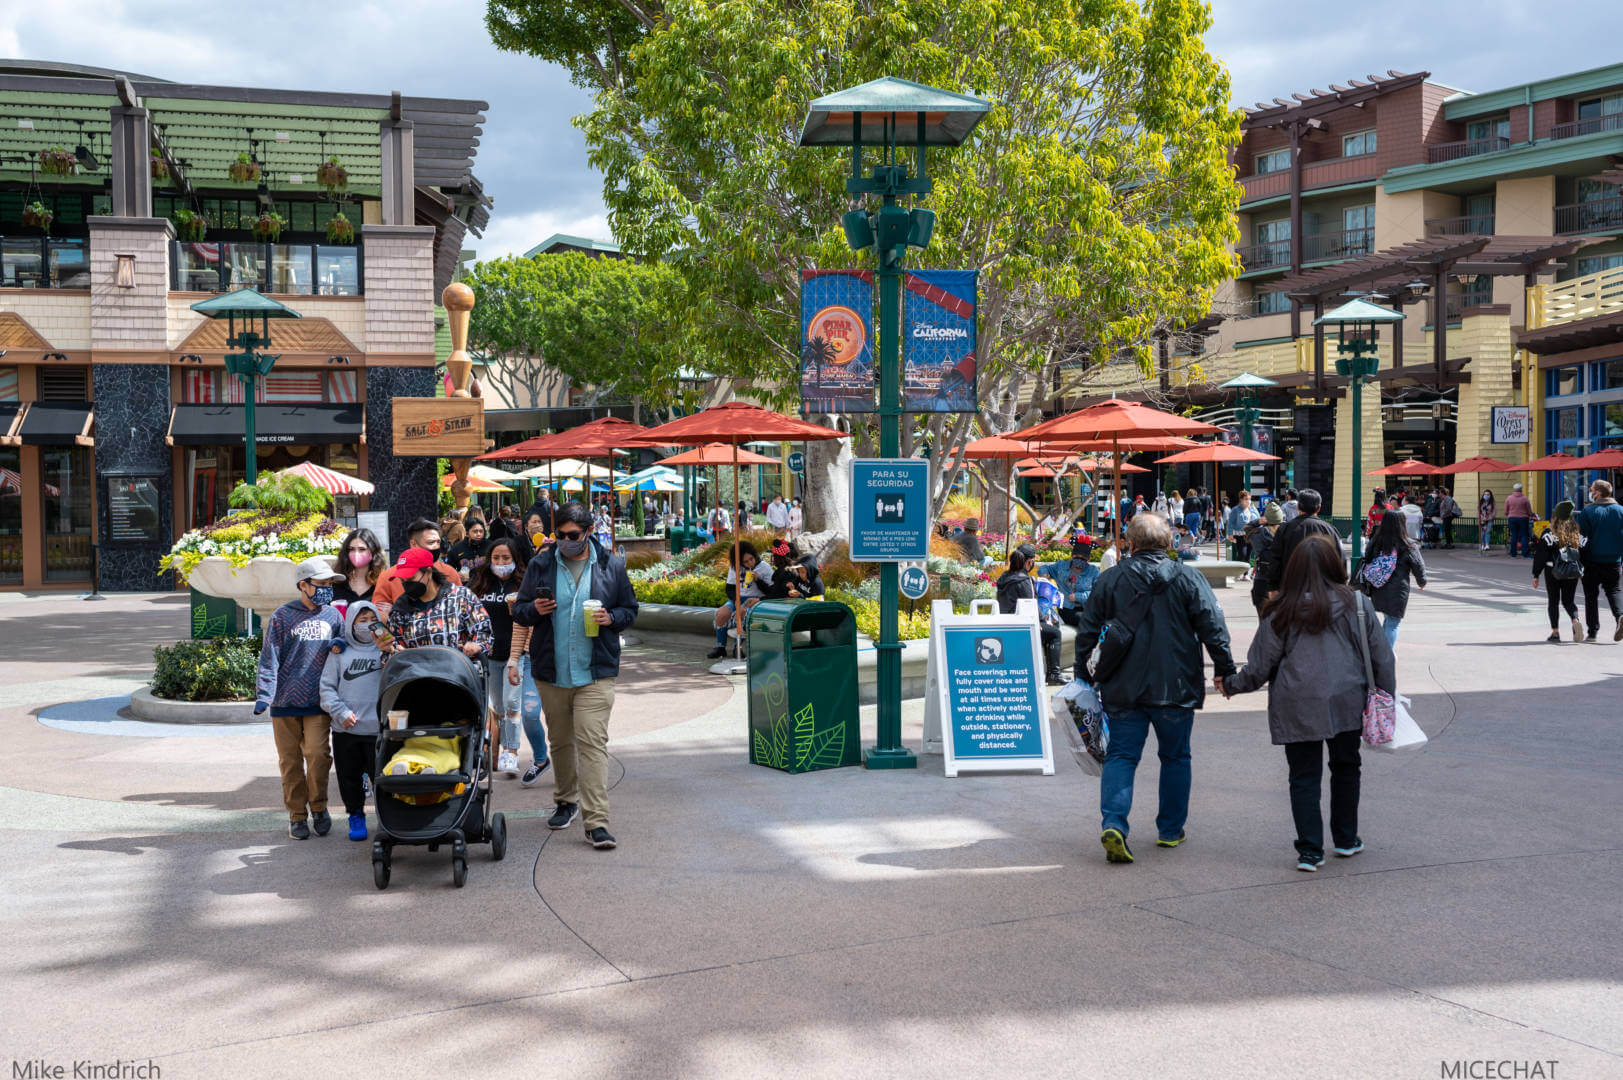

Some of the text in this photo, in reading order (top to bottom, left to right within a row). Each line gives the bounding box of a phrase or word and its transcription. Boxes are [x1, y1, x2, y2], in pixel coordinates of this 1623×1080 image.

[823, 320, 852, 332] PIXAR
[826, 329, 850, 342] PIER
[913, 329, 967, 338] CALIFORNIA
[406, 424, 427, 437] SALT
[445, 416, 472, 431] STRAW
[1496, 415, 1522, 429] Dress
[1502, 426, 1525, 440] Shop
[303, 620, 320, 628] THE
[291, 626, 320, 637] NORTH
[300, 633, 320, 642] FACE
[349, 659, 377, 671] NIKE
[975, 714, 1005, 722] drinking
[992, 723, 1032, 731] stationary,
[987, 732, 1023, 740] physically
